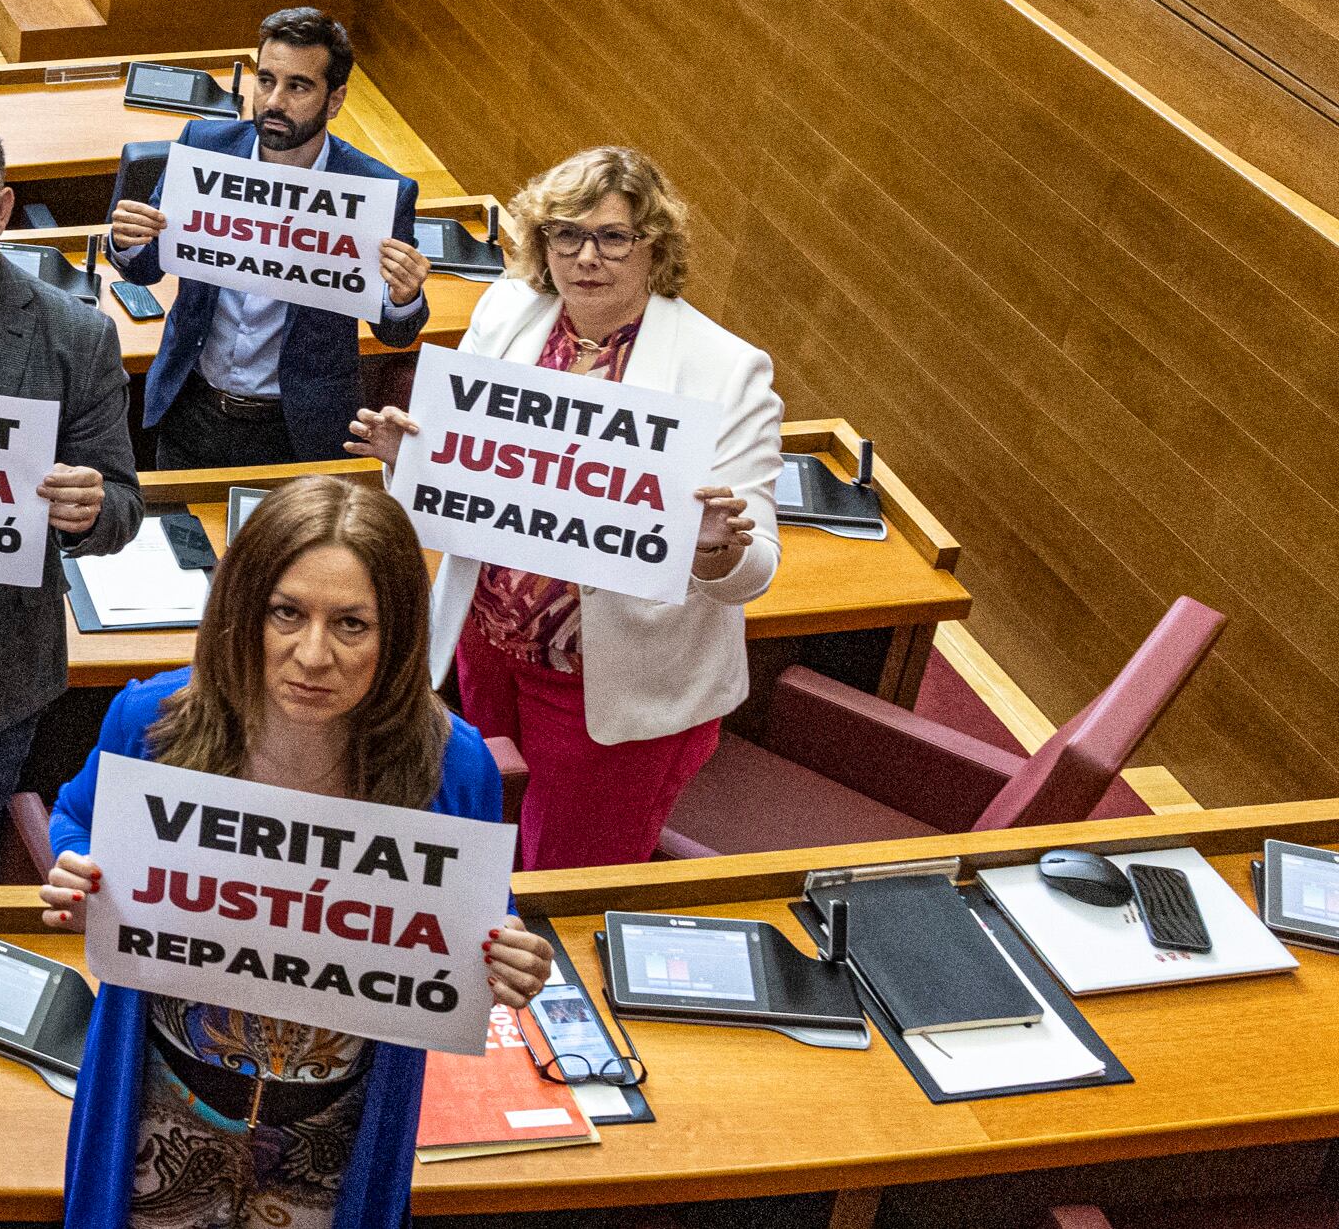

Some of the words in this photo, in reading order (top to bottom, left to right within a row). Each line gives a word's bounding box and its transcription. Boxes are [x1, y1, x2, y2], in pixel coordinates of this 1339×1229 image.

[194, 167, 365, 219] VERITAT
[177, 243, 365, 293] REPARACIÓ
[184, 211, 359, 258] JUSTÍCIA
[449, 375, 679, 451] VERITAT
[431, 431, 665, 510] JUSTÍCIA
[412, 483, 668, 562] REPARACIÓ
[146, 795, 459, 887] VERITAT
[133, 868, 449, 955] JUSTÍCIA
[117, 924, 460, 1014] REPARACIÓ
